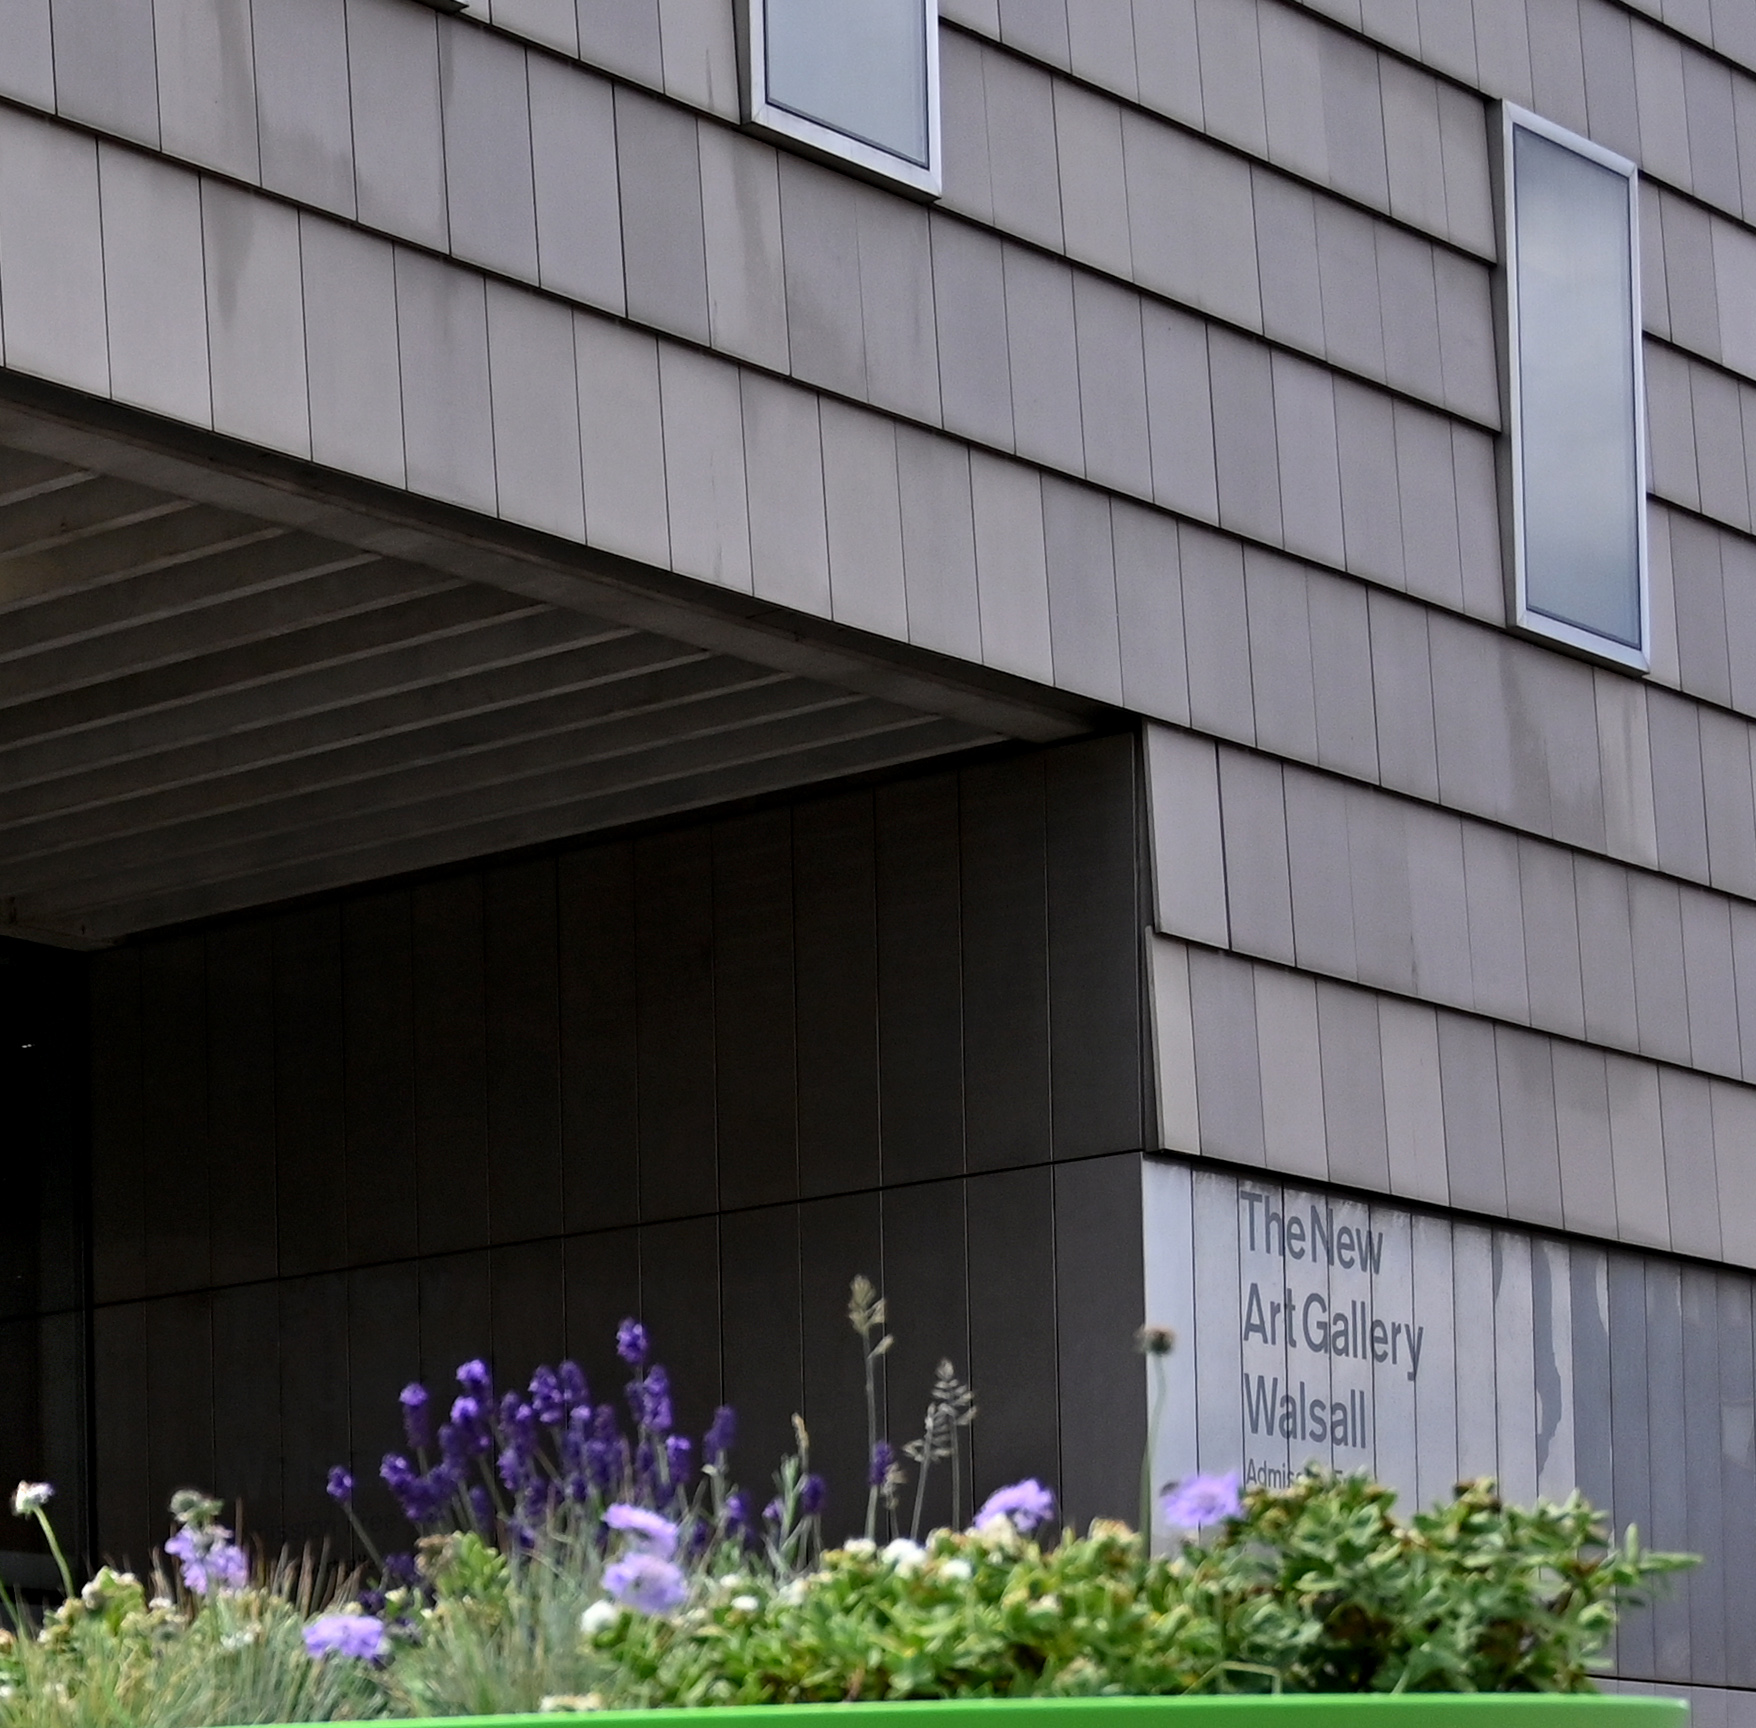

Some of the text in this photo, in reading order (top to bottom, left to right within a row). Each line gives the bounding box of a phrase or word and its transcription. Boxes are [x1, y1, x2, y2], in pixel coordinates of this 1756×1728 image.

[1239, 1190, 1384, 1276] The New
[1243, 1282, 1424, 1381] Art Gallery
[1243, 1372, 1367, 1449] Walsall
[1246, 1458, 1303, 1489] Admis
